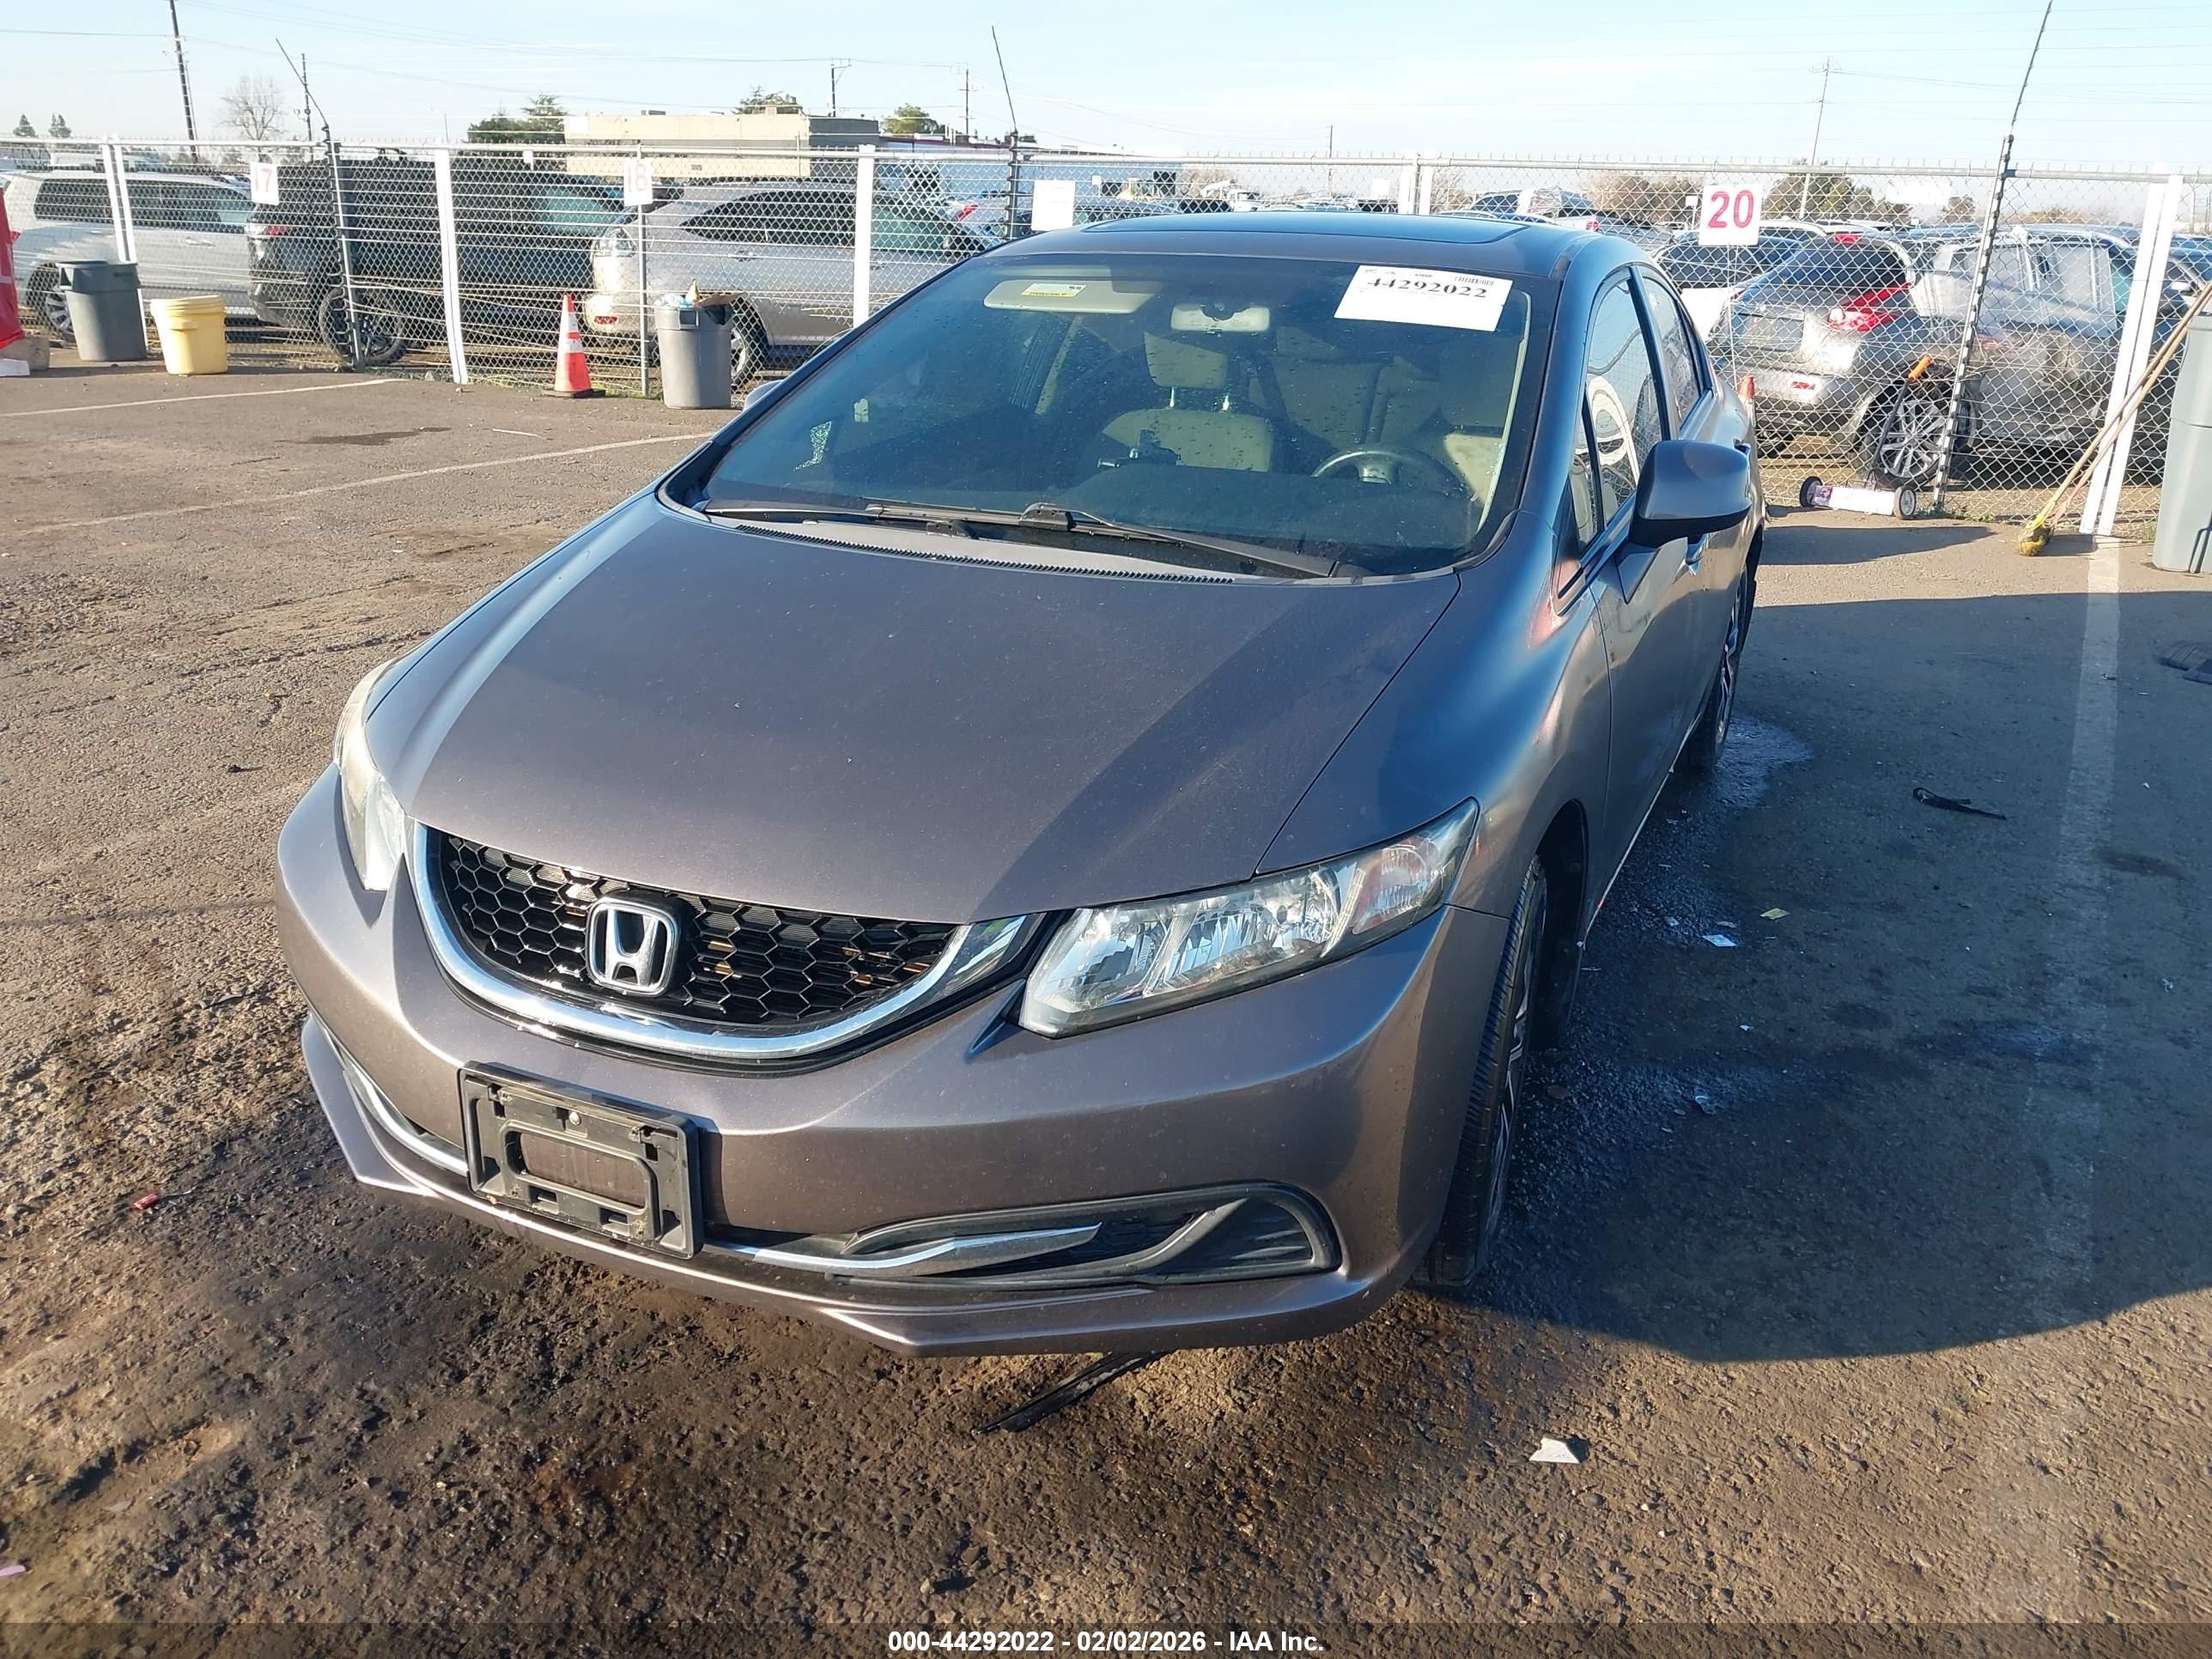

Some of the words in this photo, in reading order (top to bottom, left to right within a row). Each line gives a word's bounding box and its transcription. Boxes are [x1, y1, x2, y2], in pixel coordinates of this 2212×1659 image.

[254, 166, 274, 193] 17
[628, 163, 647, 192] 18
[1708, 189, 1754, 228] 20
[1367, 277, 1487, 298] 44292022
